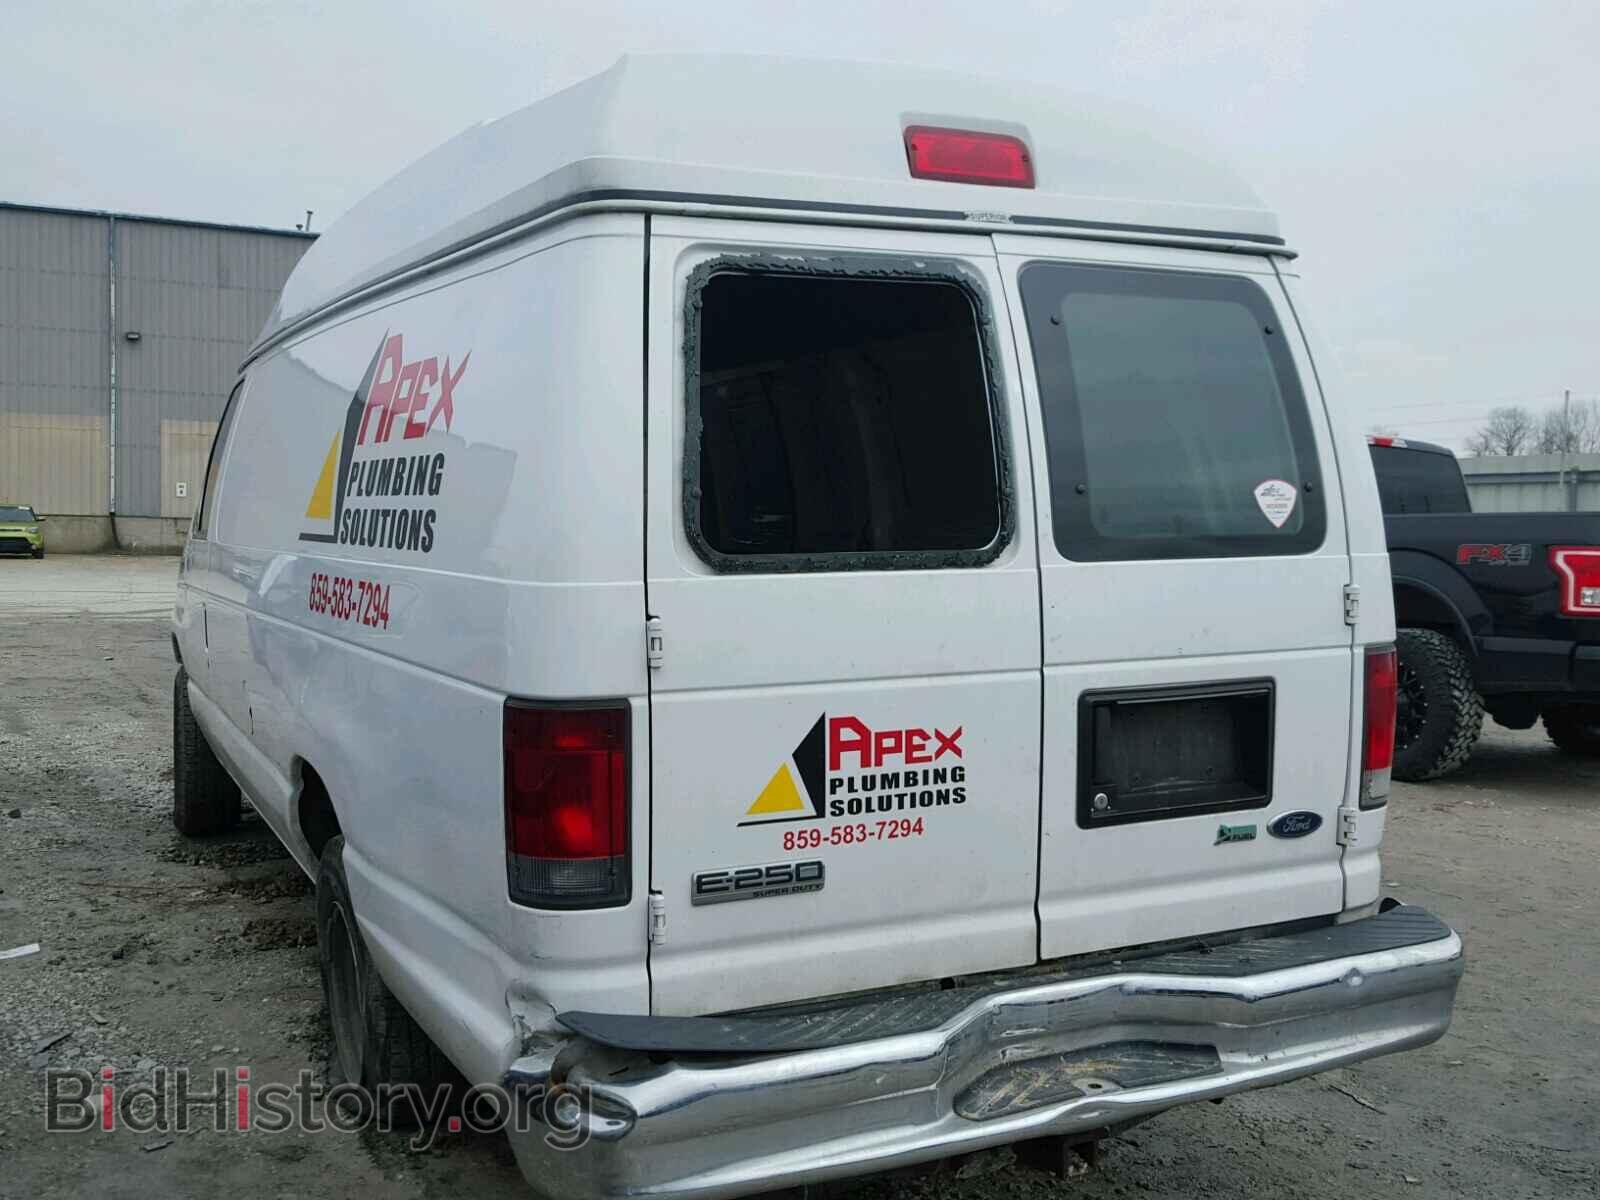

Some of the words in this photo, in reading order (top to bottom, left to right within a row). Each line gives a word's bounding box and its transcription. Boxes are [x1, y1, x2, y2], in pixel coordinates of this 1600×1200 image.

[358, 333, 472, 446] APEX
[346, 452, 446, 497] PLUMBING
[339, 507, 437, 553] SOLUTIONS
[309, 572, 390, 631] 859-583-7294
[828, 716, 963, 772] APEX
[829, 766, 966, 795] PLUMBING
[829, 787, 967, 817] SOLUTIONS
[783, 817, 925, 851] 859-583-7294
[1282, 814, 1312, 833] Ford
[695, 860, 824, 894] E-250
